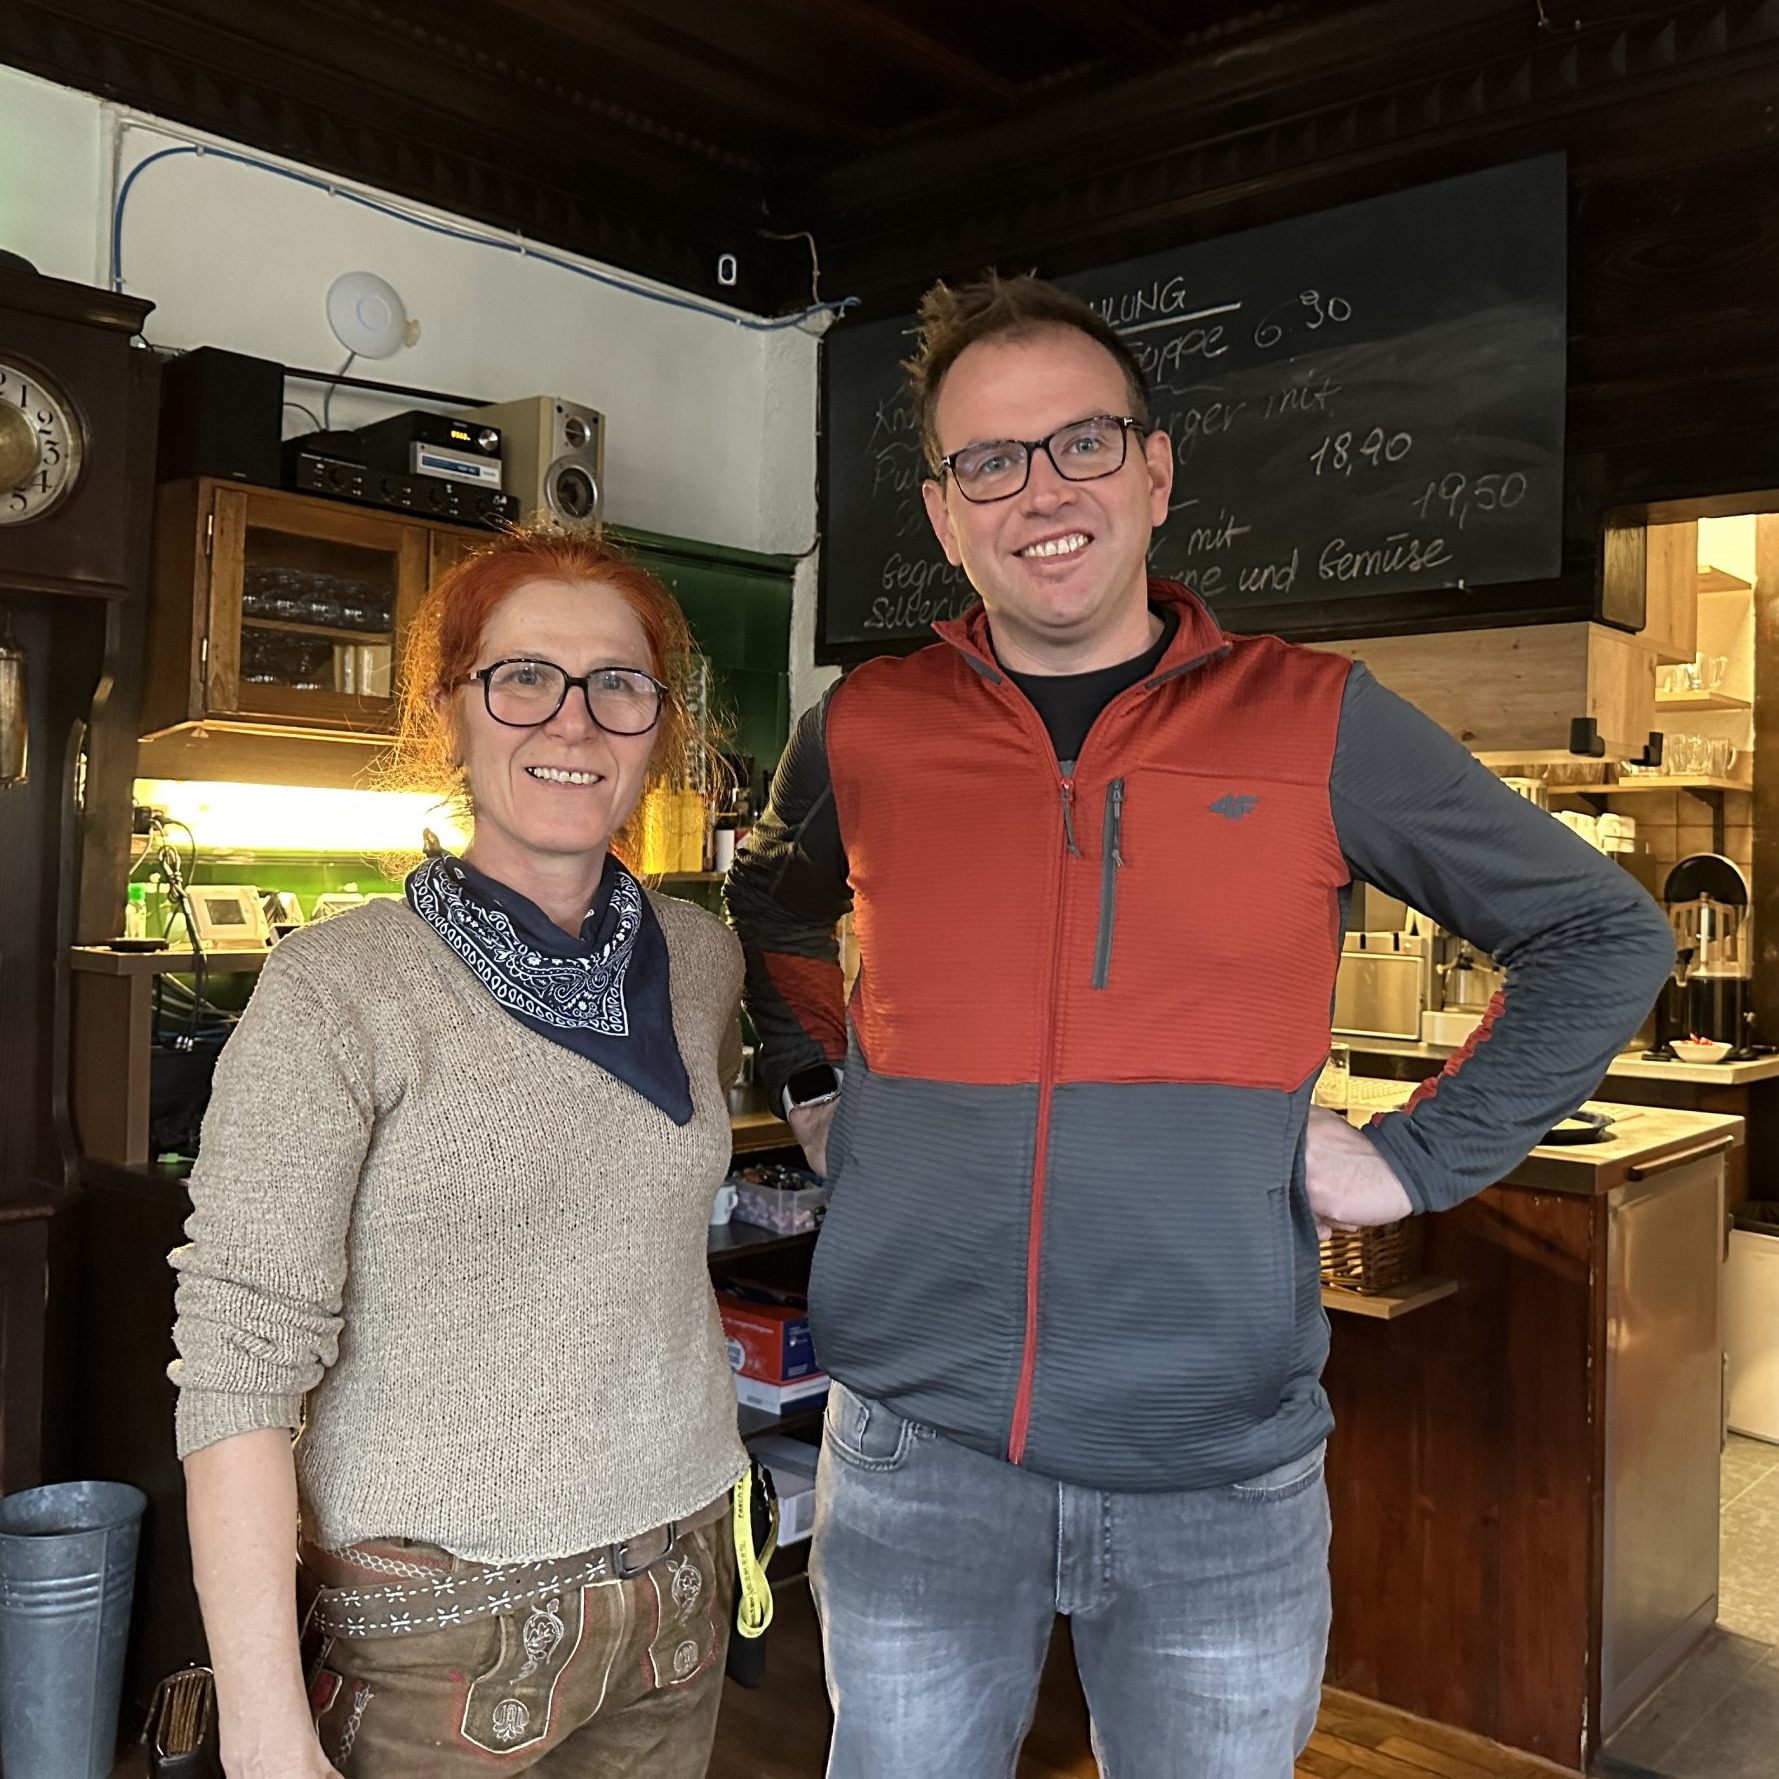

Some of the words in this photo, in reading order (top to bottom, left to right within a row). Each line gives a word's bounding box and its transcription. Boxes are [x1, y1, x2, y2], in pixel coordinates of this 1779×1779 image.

[37, 410, 53, 435] 2
[44, 440, 60, 465] 3
[1310, 427, 1412, 476] 18,90
[1188, 508, 1252, 556] mit
[1412, 472, 1528, 529] 19,50
[1238, 549, 1299, 593] und
[1320, 533, 1452, 580] Gemüse
